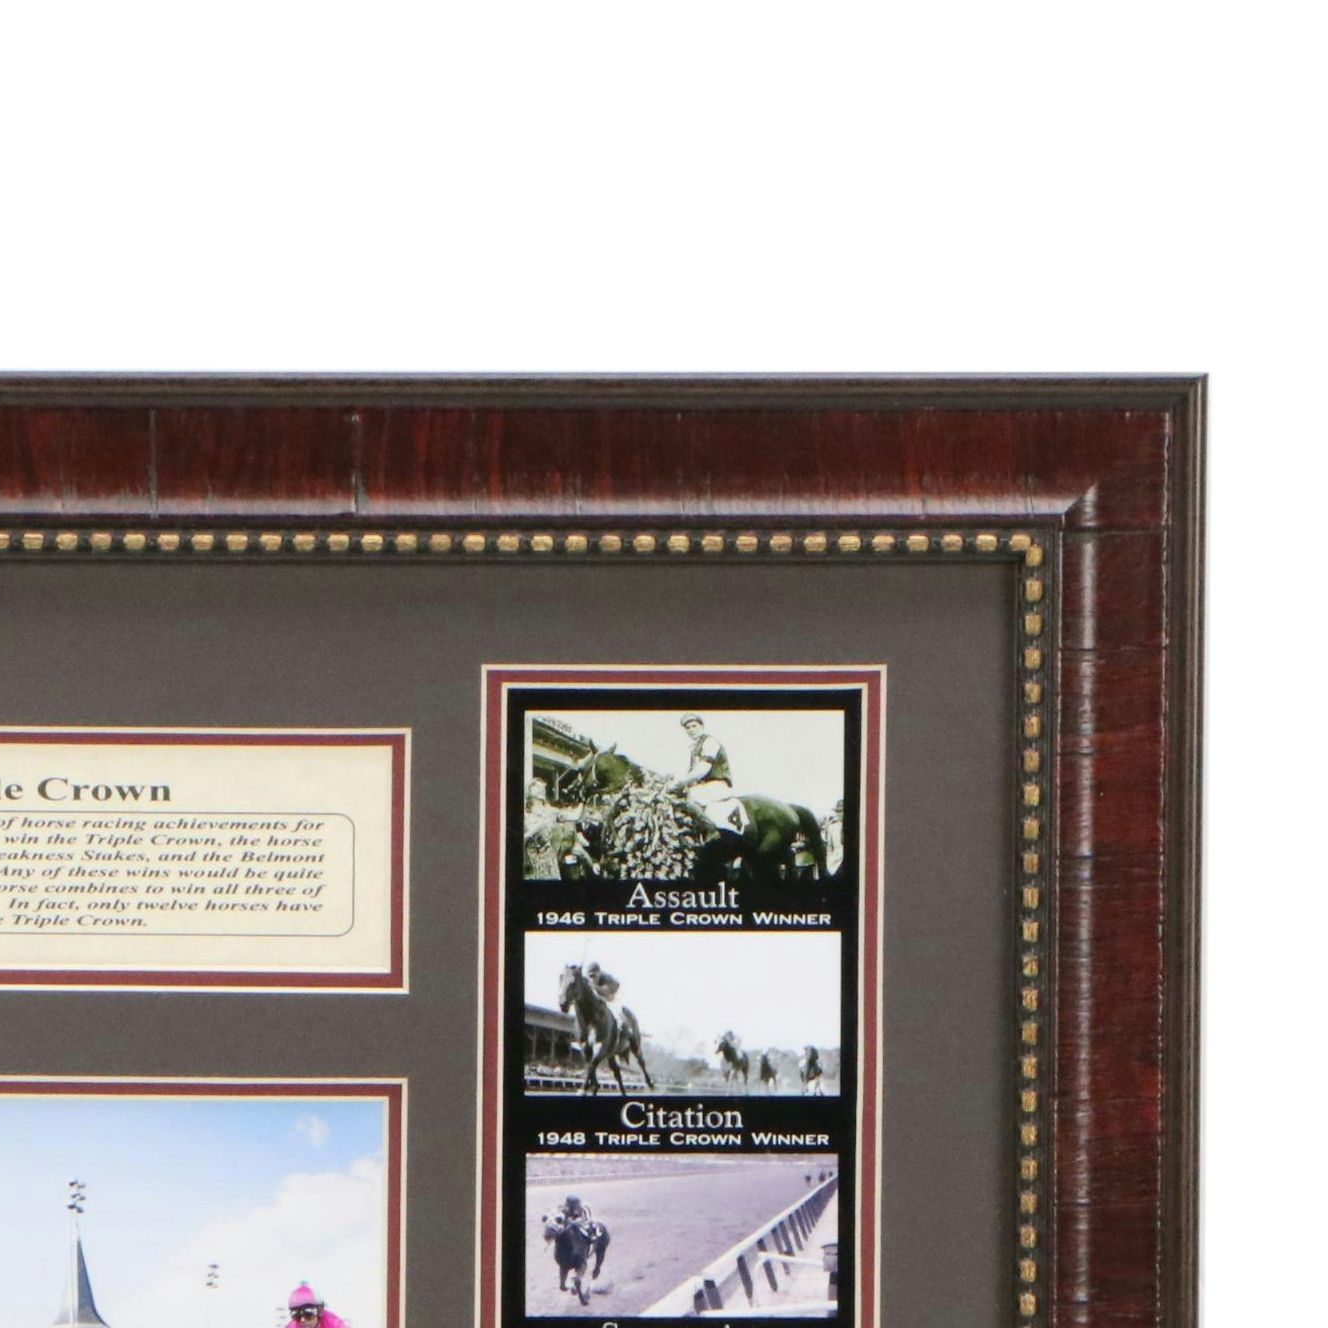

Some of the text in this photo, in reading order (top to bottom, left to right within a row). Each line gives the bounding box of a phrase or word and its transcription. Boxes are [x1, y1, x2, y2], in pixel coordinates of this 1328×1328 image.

[37, 777, 171, 801] Crown
[20, 817, 76, 828] horse
[82, 817, 147, 832] racing
[153, 818, 287, 830] achievements
[291, 819, 324, 833] for
[4, 833, 39, 844] win
[46, 833, 77, 844] the
[86, 833, 143, 848] Triple
[150, 834, 222, 847] Crown,
[229, 835, 261, 846] the
[266, 835, 322, 847] horse
[625, 881, 739, 908] Assault
[13, 914, 69, 928] Triple
[76, 915, 146, 926] Crown.
[537, 911, 585, 925] 1946
[620, 1101, 743, 1128] Citation
[538, 1131, 586, 1145] 1948
